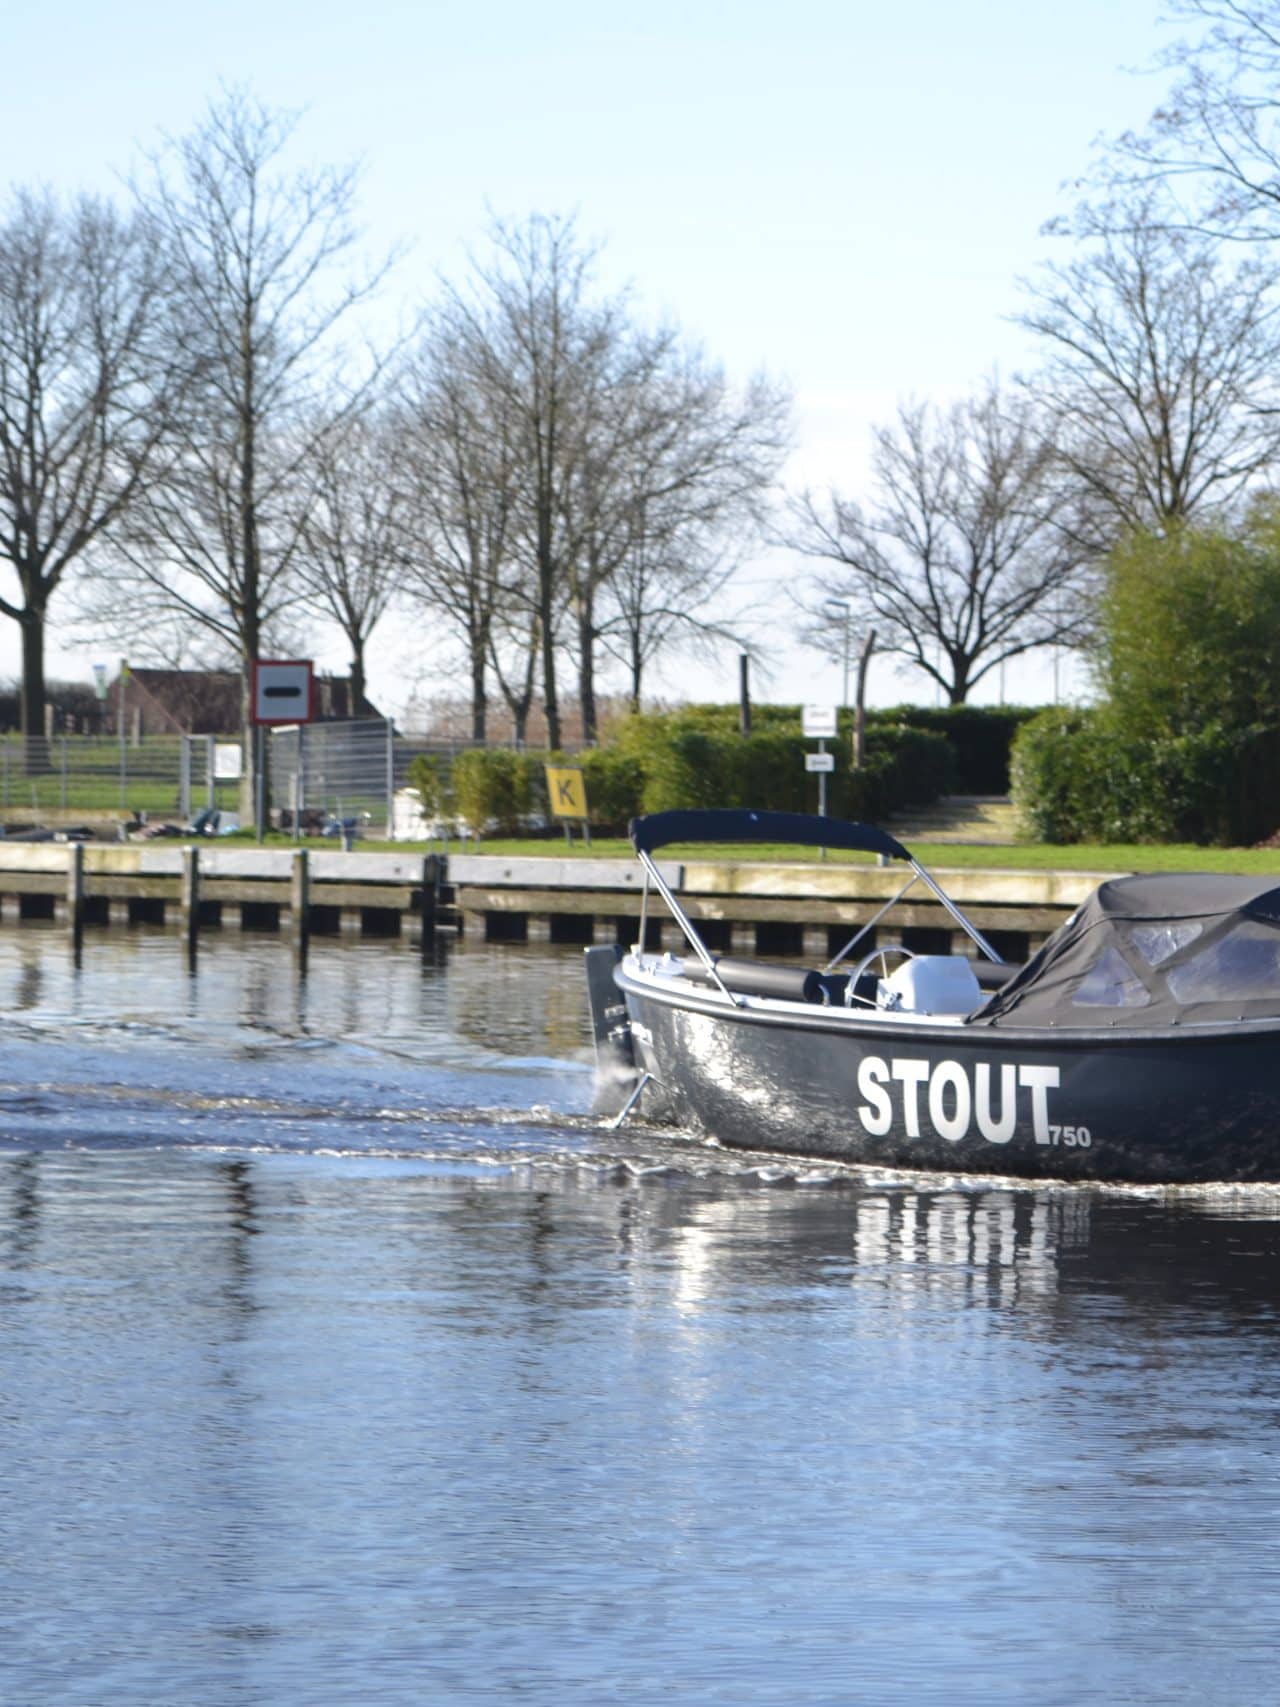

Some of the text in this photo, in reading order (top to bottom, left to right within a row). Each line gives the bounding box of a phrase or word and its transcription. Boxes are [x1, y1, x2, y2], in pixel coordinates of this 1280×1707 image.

[556, 779, 576, 806] K
[857, 1056, 1060, 1145] STOUT
[1049, 1125, 1091, 1148] 750
